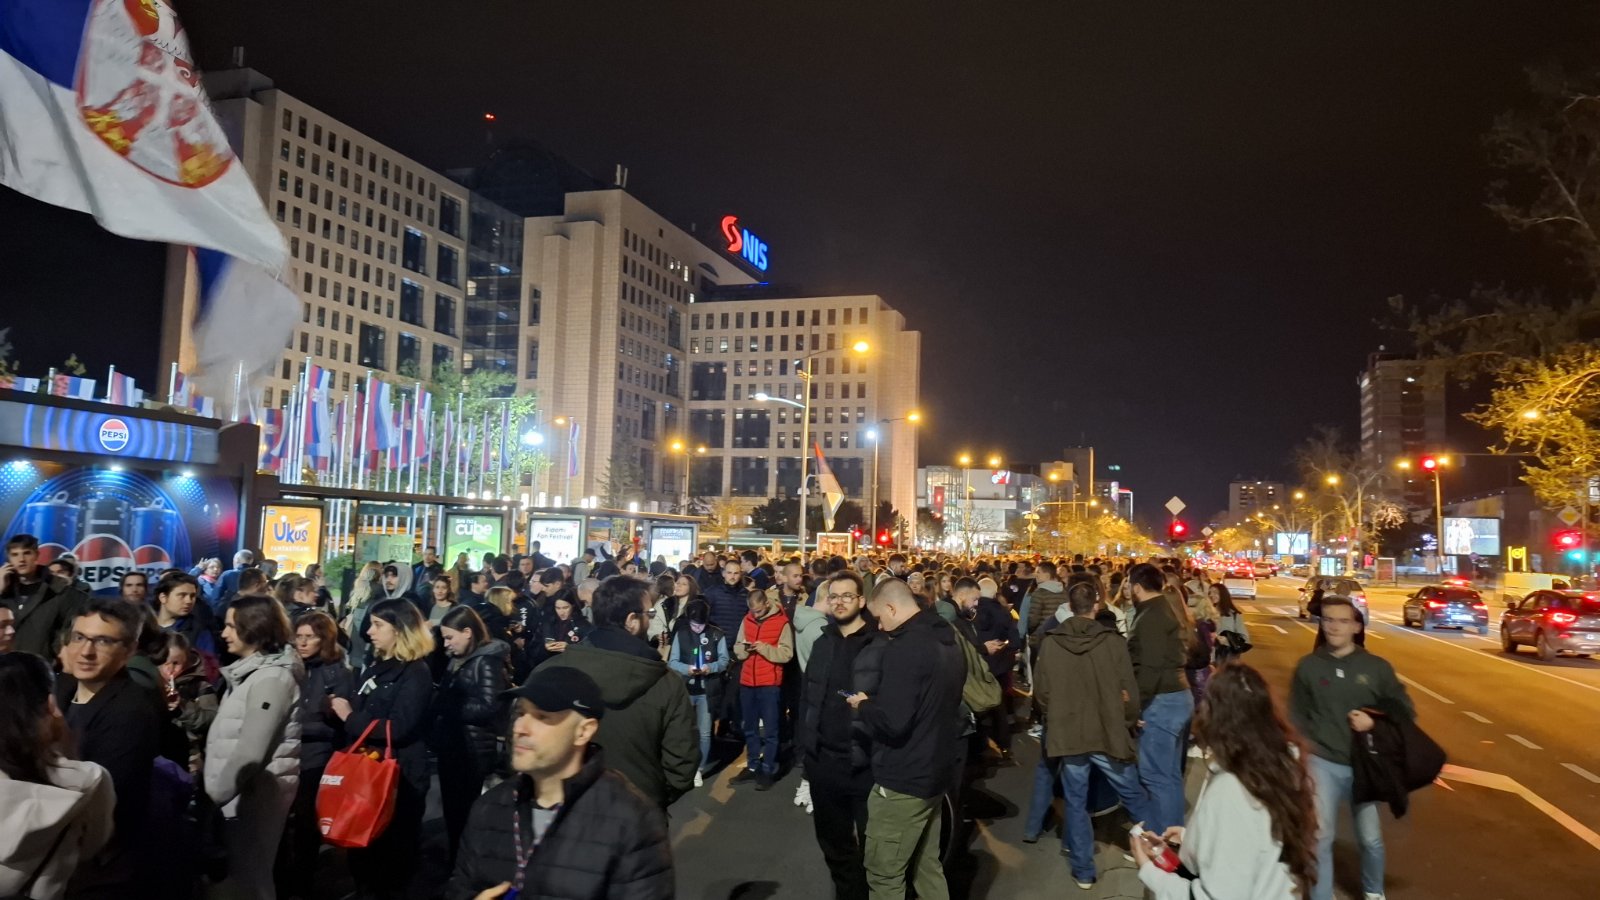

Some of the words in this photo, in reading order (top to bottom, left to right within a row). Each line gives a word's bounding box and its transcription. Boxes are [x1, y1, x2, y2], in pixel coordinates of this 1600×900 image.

[743, 228, 767, 271] NIS
[102, 430, 127, 440] PEPSI
[455, 520, 493, 535] cube
